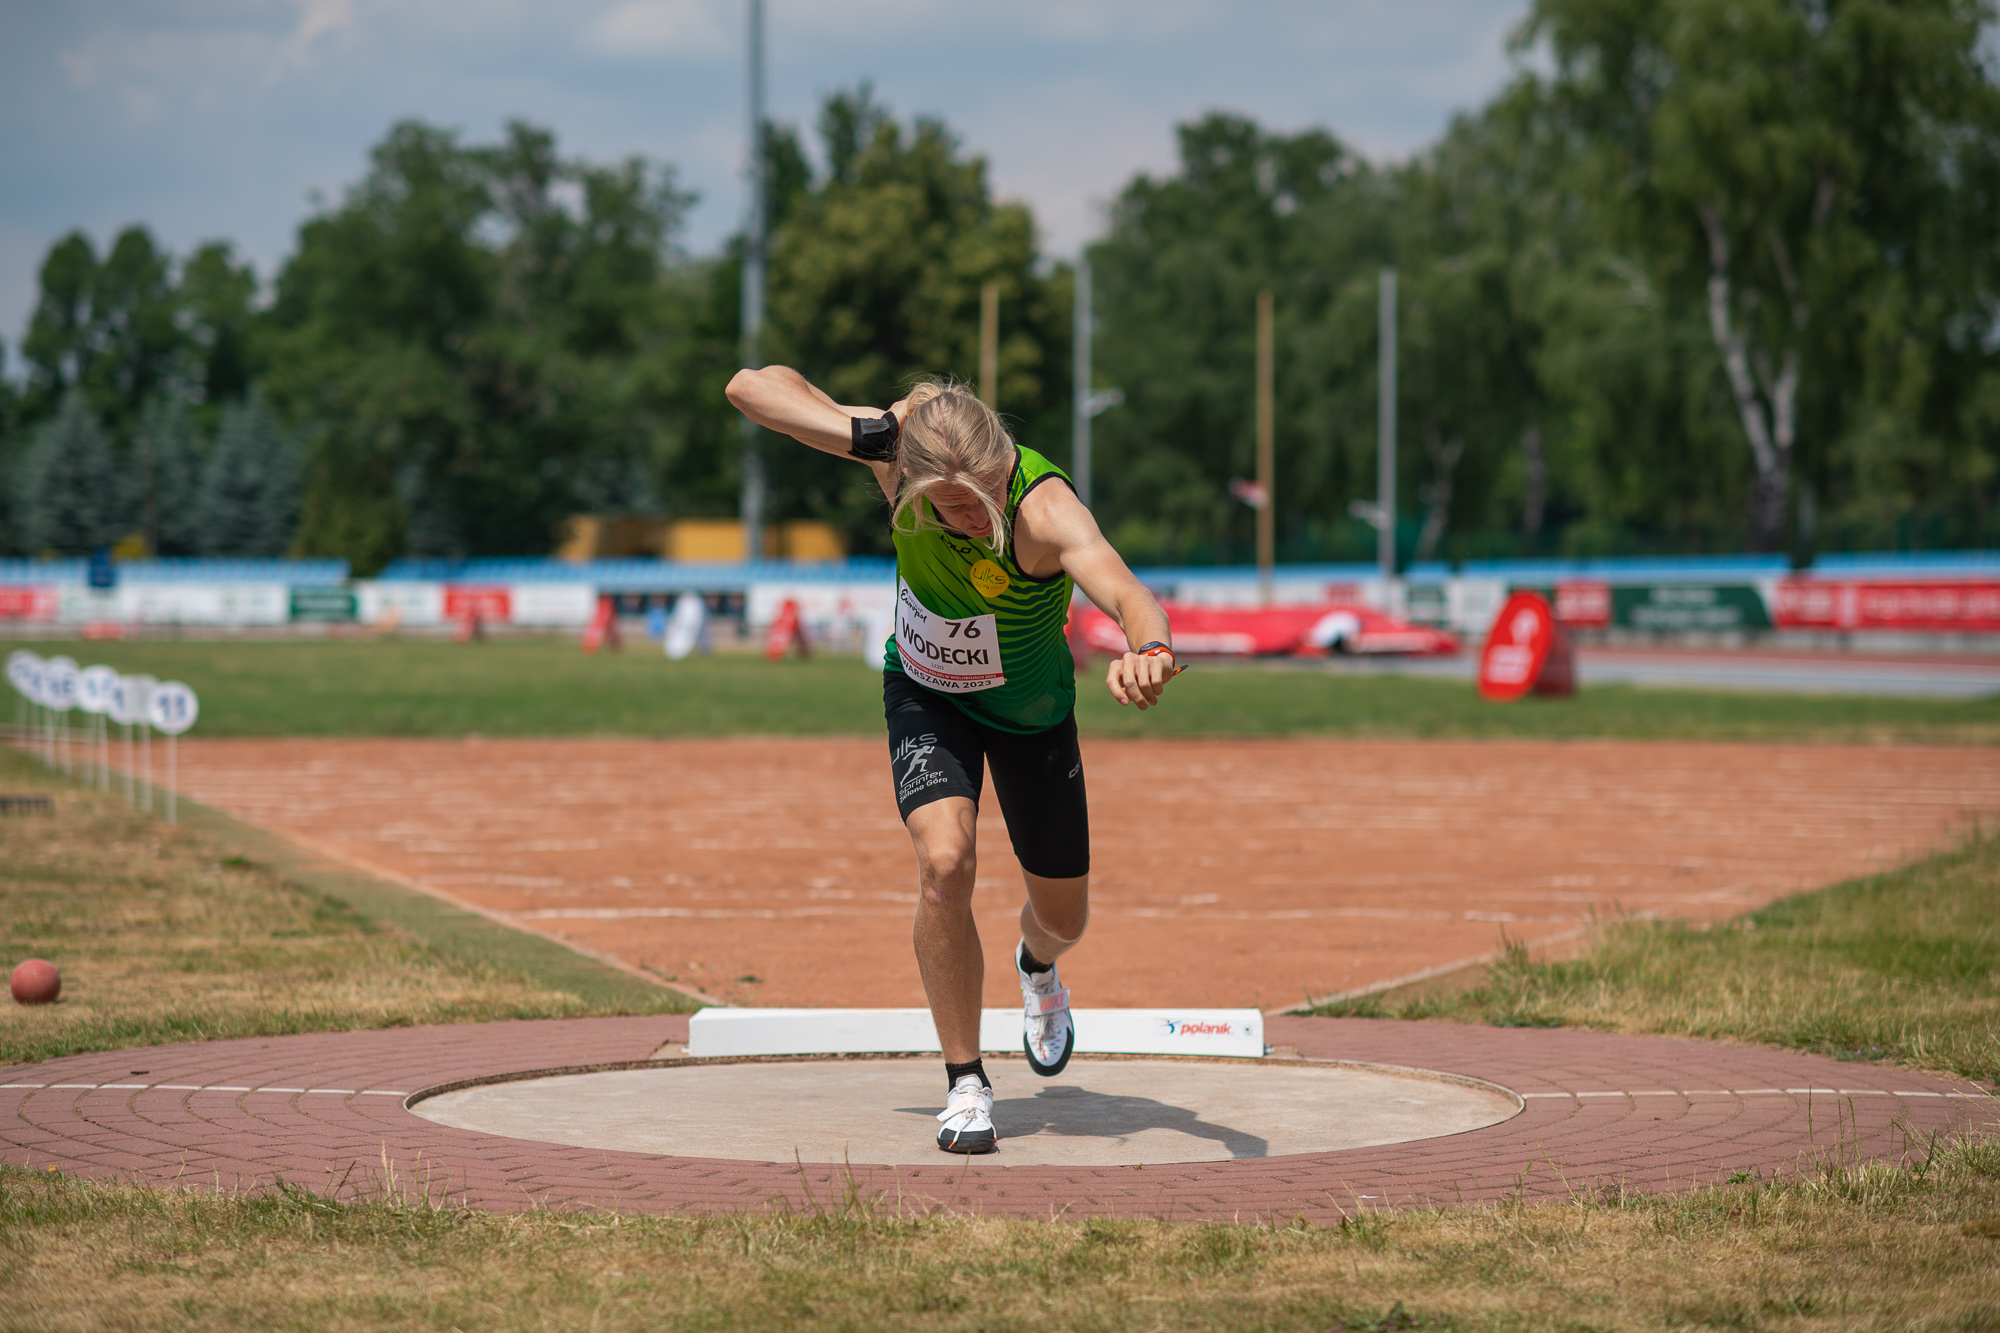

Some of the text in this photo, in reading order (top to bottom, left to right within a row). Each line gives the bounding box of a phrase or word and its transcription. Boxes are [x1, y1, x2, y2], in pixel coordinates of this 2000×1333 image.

[945, 620, 981, 638] 76
[902, 617, 989, 665] WODECKI
[902, 656, 992, 688] WARSZAWA 2023
[1039, 992, 1065, 1011] NIKE
[1180, 1022, 1231, 1036] polanik
